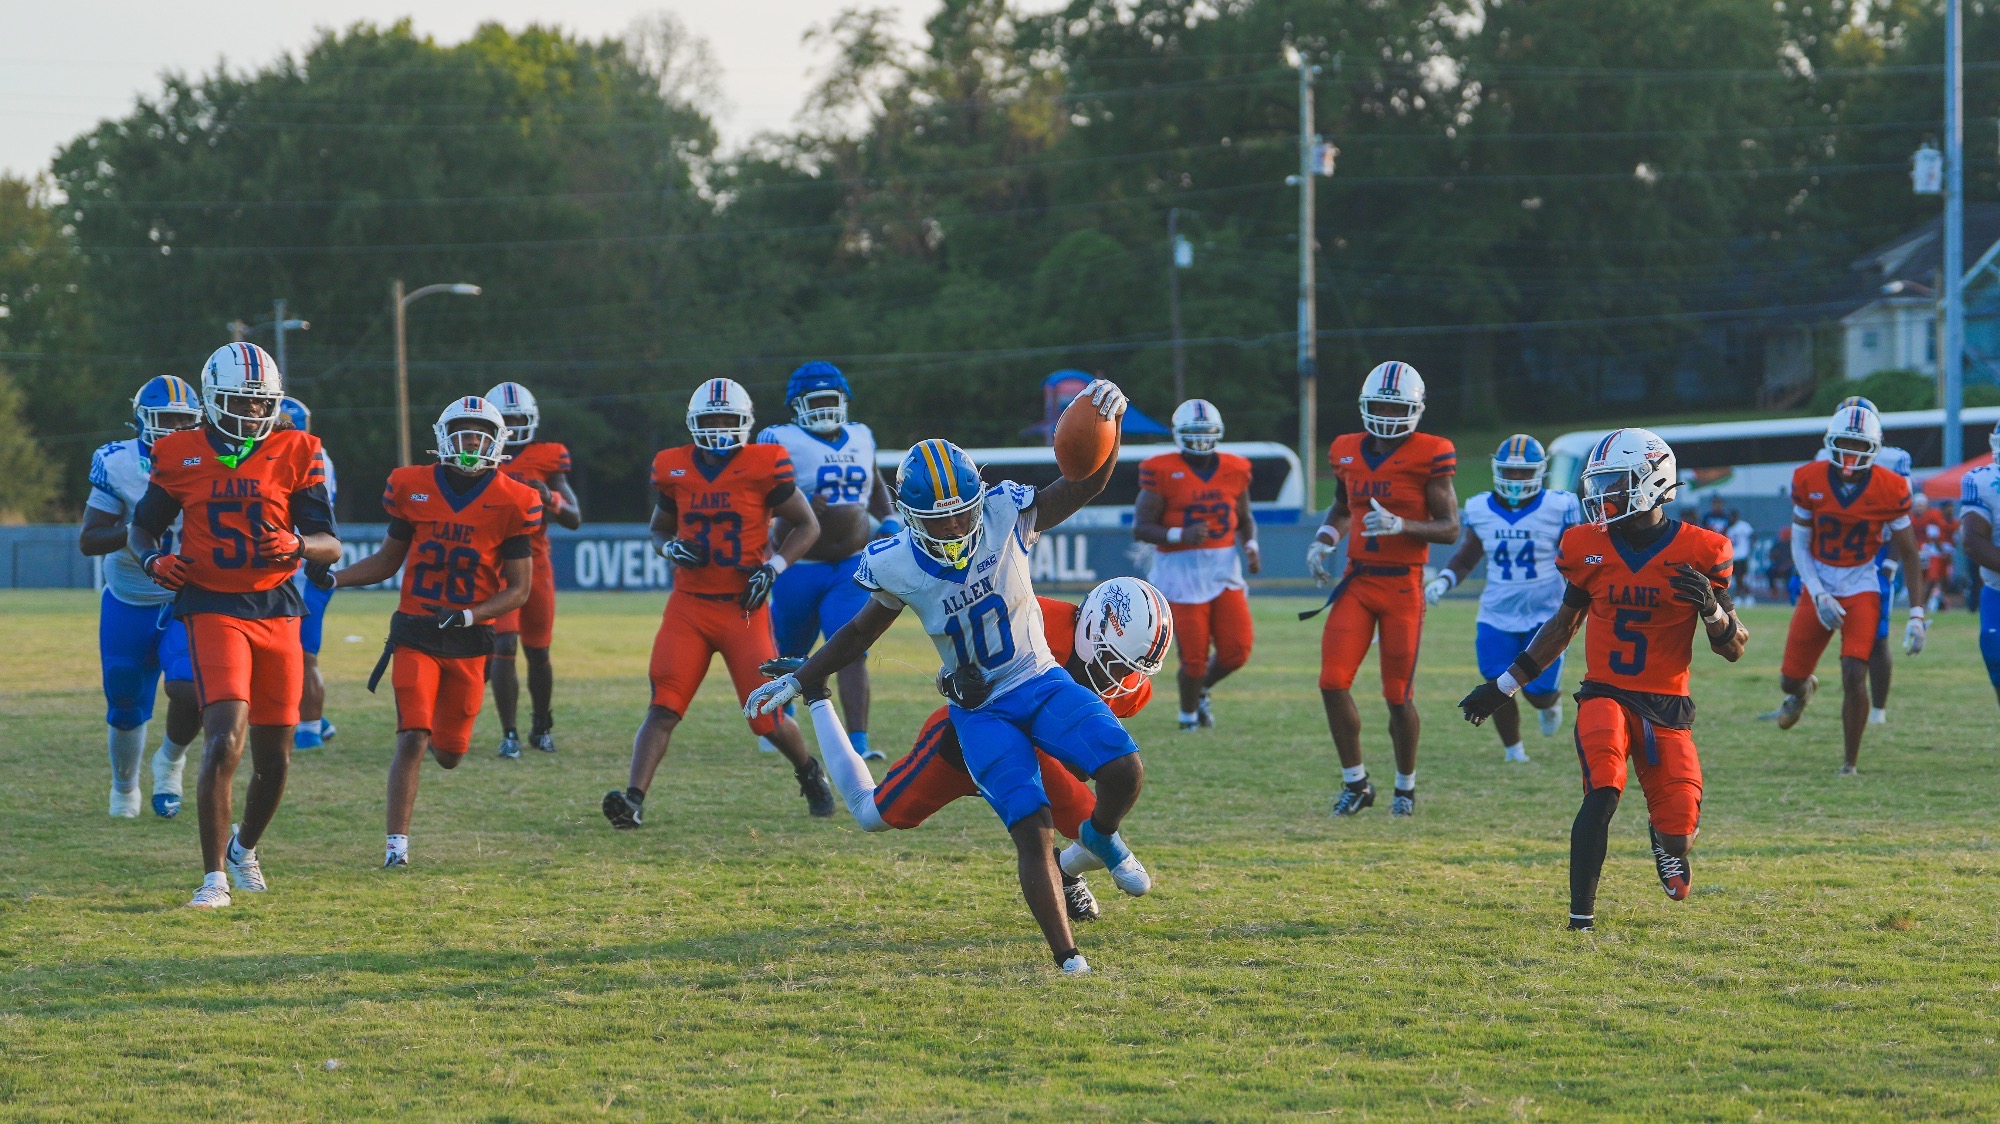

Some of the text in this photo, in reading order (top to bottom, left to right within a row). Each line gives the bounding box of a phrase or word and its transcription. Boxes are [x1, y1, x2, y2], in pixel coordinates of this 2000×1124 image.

[824, 454, 855, 464] ALLEN
[211, 478, 262, 499] LANE
[690, 491, 732, 509] LANE
[816, 465, 867, 503] 68
[1352, 481, 1392, 498] LANE
[207, 501, 269, 569] 51
[432, 520, 475, 544] LANE
[683, 511, 742, 567] 33
[1184, 502, 1231, 539] 63
[1495, 529, 1531, 540] ALLEN
[1817, 514, 1869, 561] 24
[410, 540, 480, 605] 28
[575, 540, 668, 588] OVER
[1494, 540, 1538, 580] 44
[942, 575, 994, 615] ALLEN
[1608, 584, 1661, 608] LANE
[944, 592, 1016, 671] 10
[1608, 608, 1651, 677] 5
